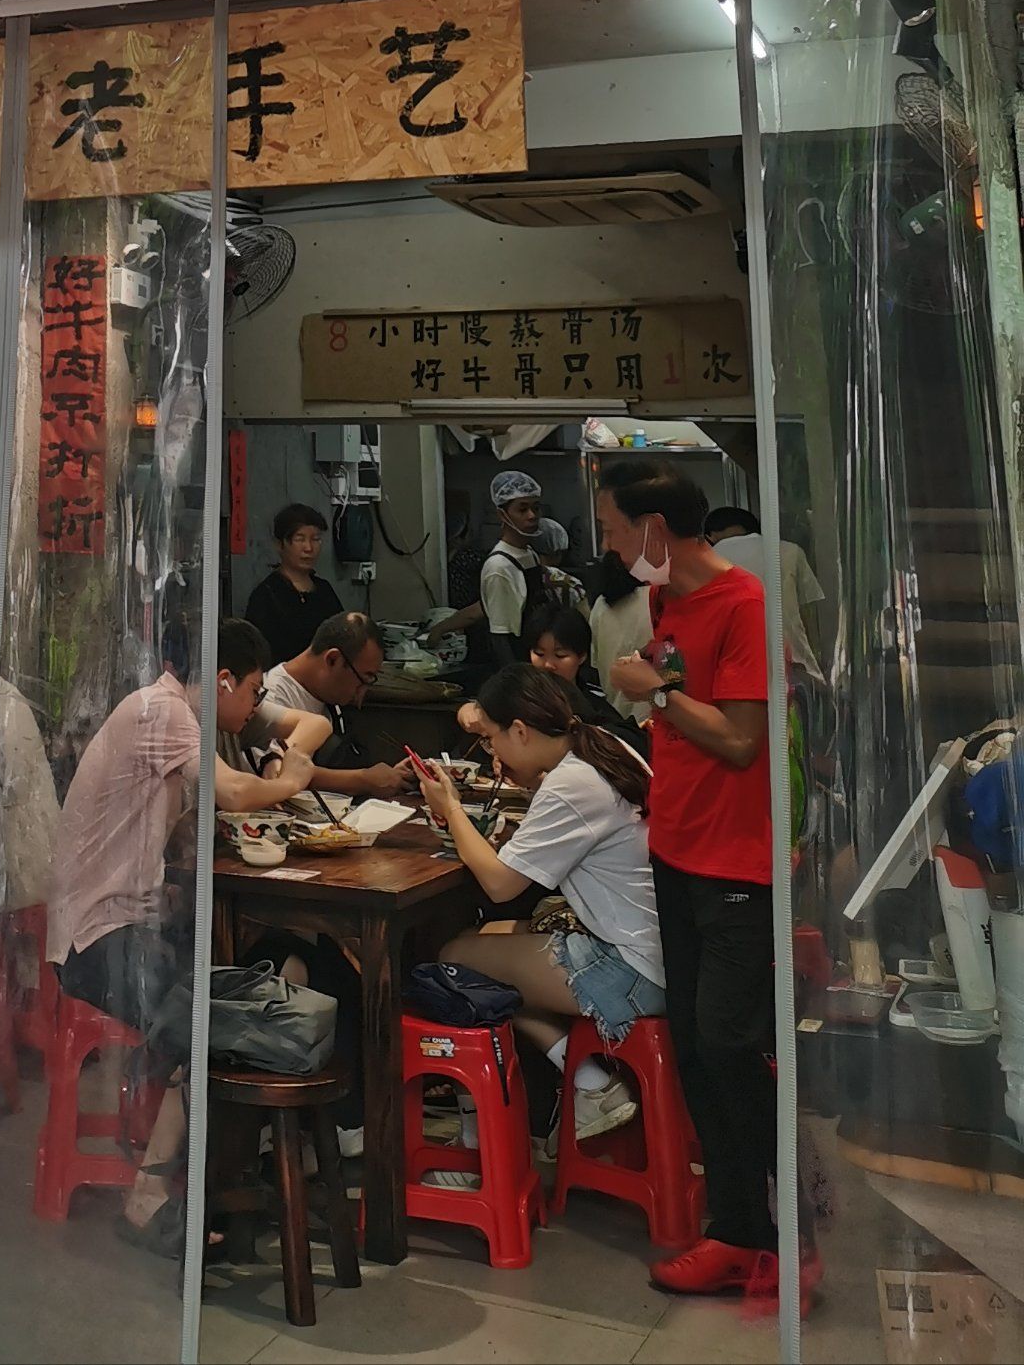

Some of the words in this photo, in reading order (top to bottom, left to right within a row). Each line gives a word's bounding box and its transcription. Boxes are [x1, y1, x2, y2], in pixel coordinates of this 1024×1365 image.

[328, 306, 643, 353] 8小时慢熬骨汤
[410, 343, 744, 396] 好牛骨只用1次
[40, 255, 106, 549] 好牛肉不打折
